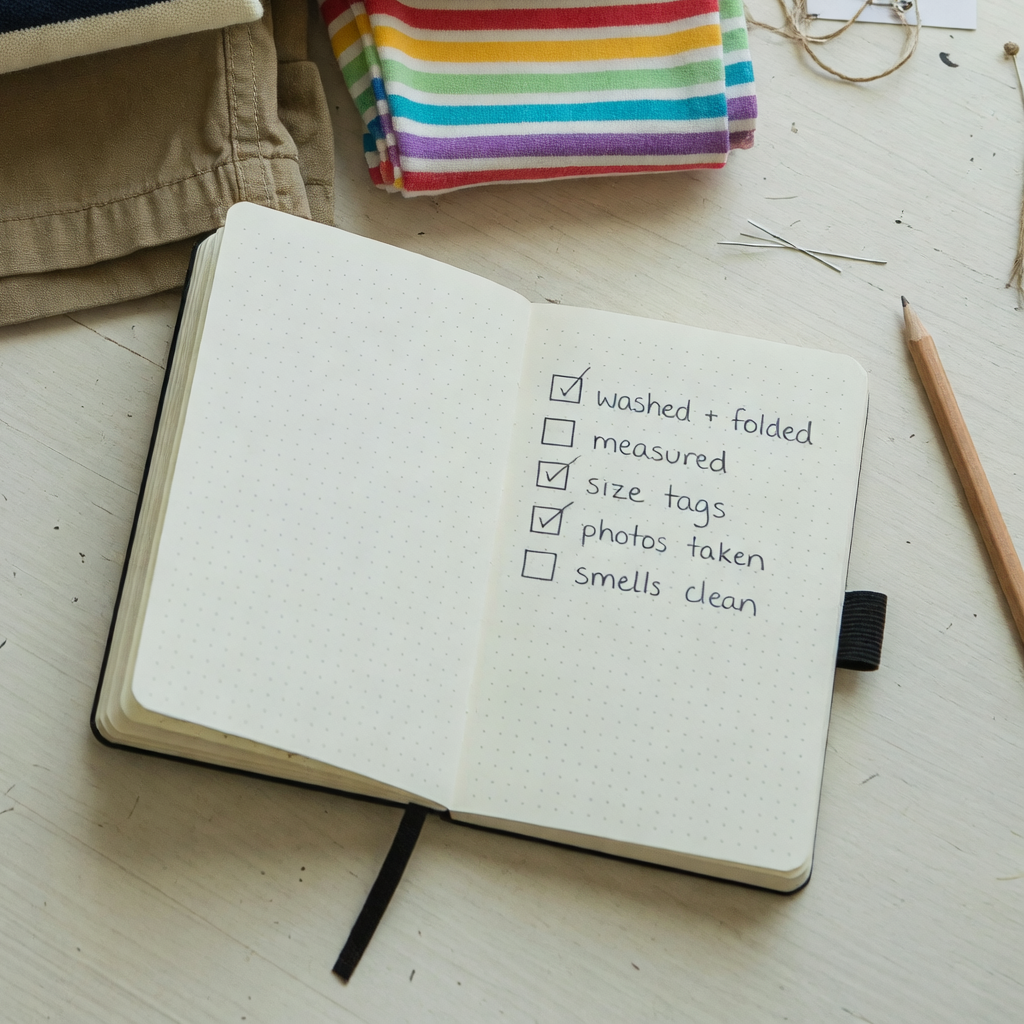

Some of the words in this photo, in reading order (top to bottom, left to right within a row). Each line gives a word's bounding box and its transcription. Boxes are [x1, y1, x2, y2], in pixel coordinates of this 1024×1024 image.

[597, 390, 692, 423] washed
[705, 410, 719, 422] +
[731, 407, 814, 446] folded
[593, 434, 727, 474] measured
[586, 477, 645, 503] size
[664, 484, 726, 528] tags
[581, 519, 667, 553] photos
[687, 536, 765, 571] taken
[574, 567, 661, 597] smells
[684, 580, 758, 617] clean
